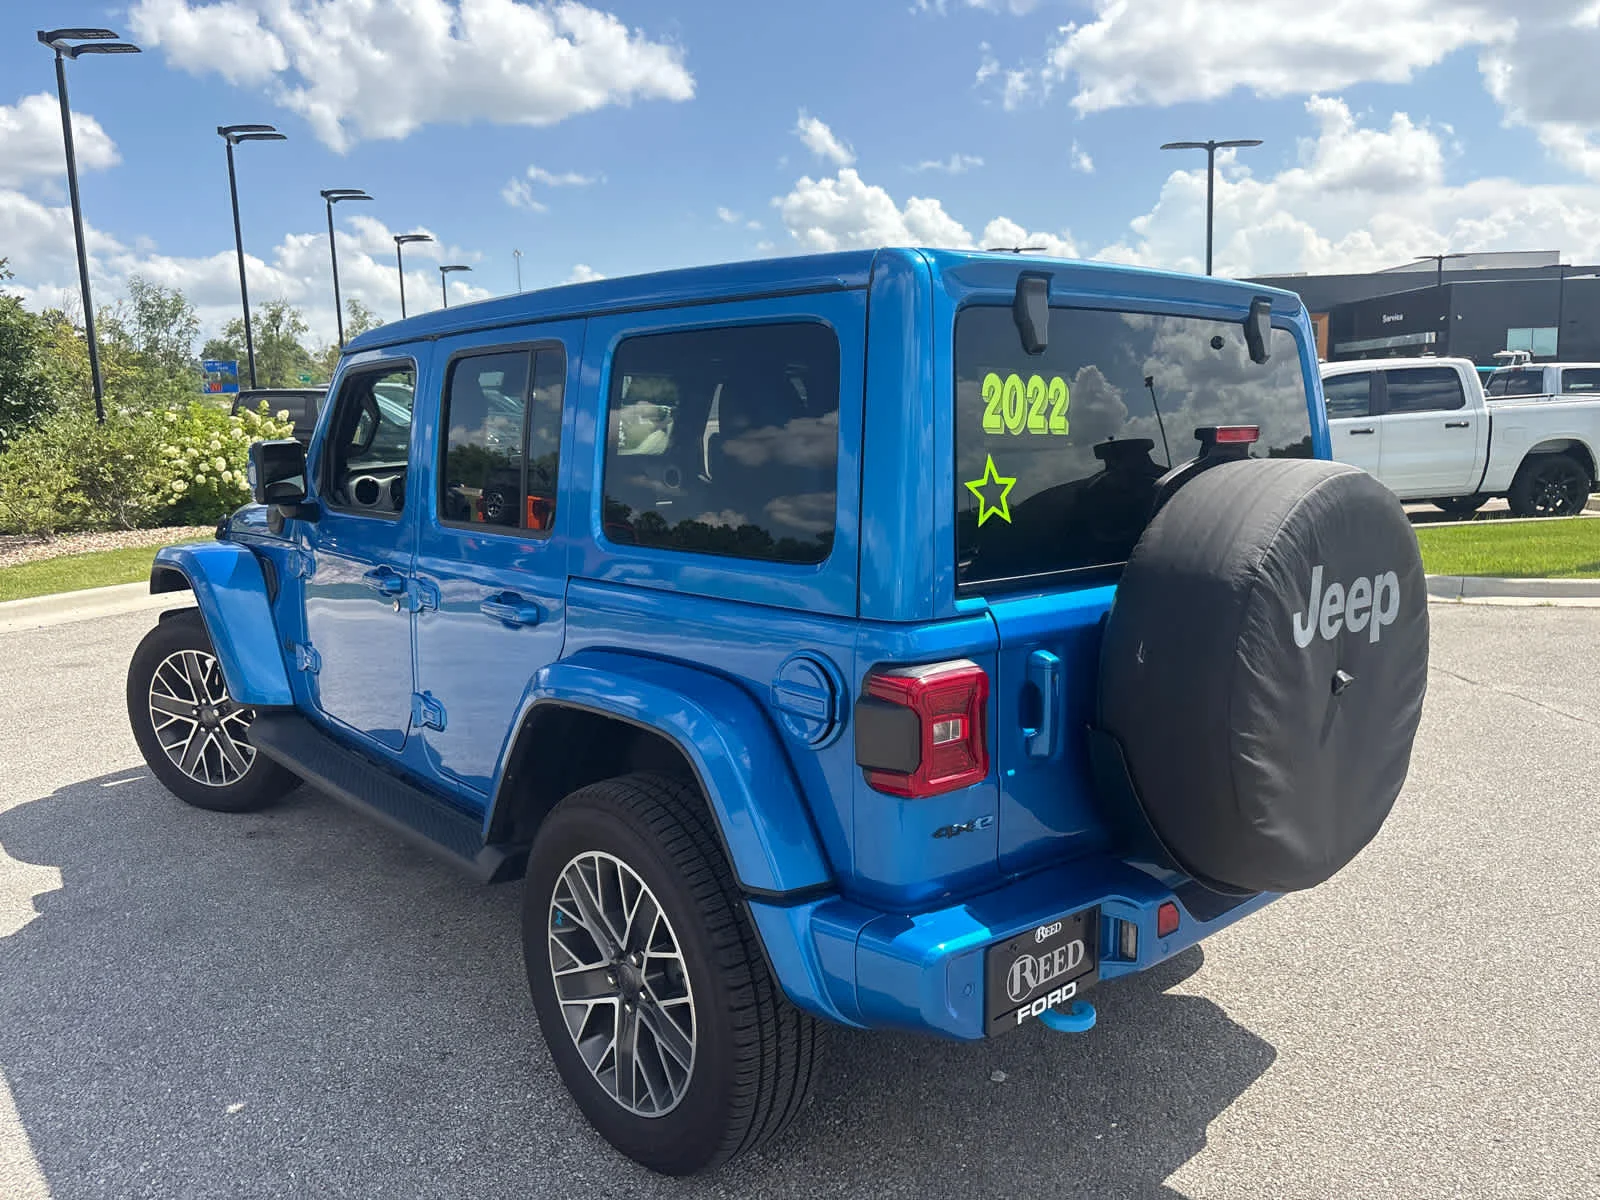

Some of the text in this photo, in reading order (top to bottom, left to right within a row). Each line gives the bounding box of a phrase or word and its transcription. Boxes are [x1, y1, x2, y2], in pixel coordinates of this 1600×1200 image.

[1382, 313, 1404, 323] Service
[982, 372, 1070, 436] 2022
[1293, 565, 1400, 648] Jeep
[1035, 921, 1062, 943] REED
[1007, 939, 1085, 1002] REED
[1017, 981, 1077, 1025] FORD
